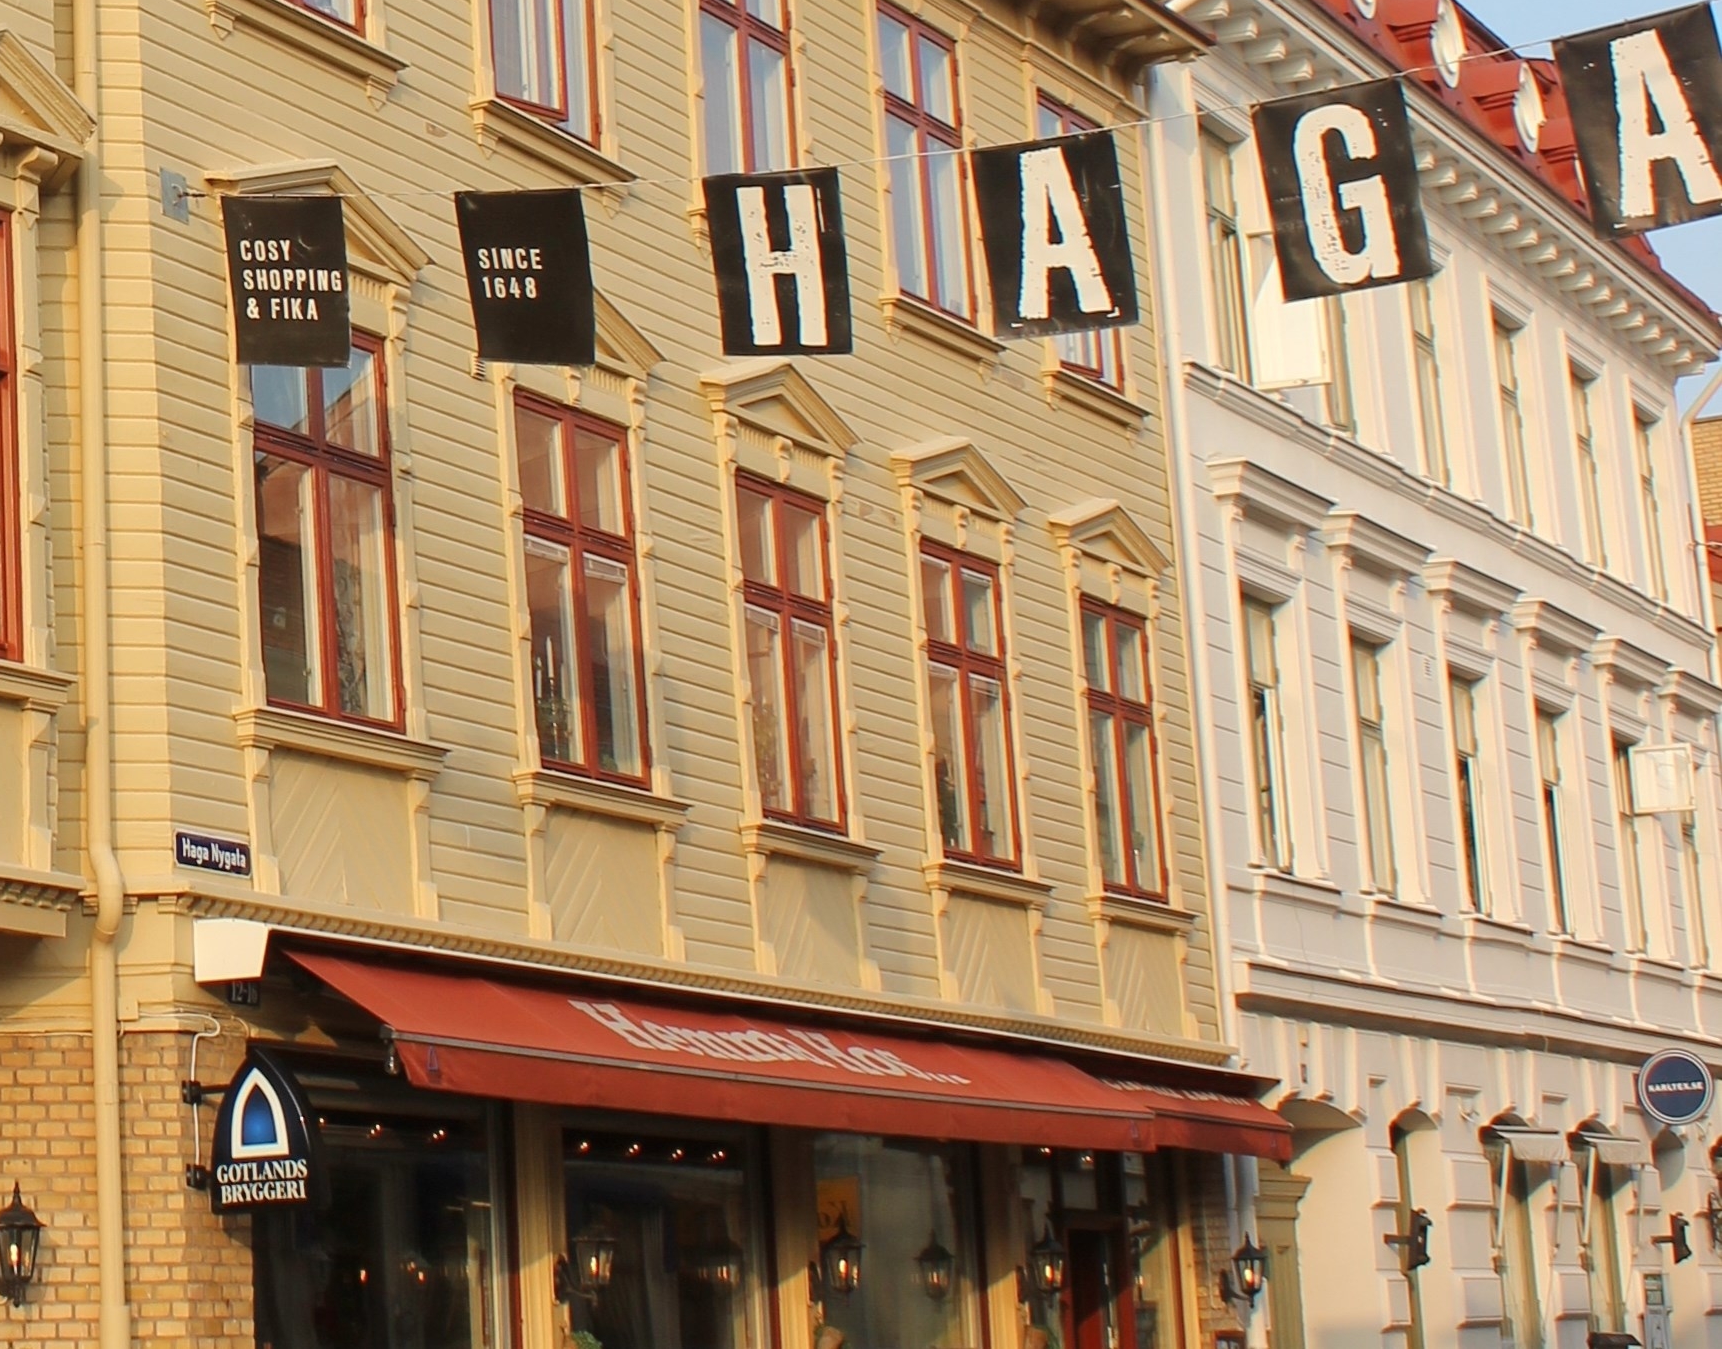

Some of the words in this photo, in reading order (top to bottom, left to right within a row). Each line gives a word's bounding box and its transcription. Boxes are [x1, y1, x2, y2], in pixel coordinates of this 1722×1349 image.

[239, 239, 291, 262] COSY
[477, 247, 543, 270] SINCE
[242, 268, 343, 292] SHOPPING
[481, 276, 537, 299] 1648
[246, 297, 261, 320] &
[270, 297, 319, 322] FIKA
[181, 837, 210, 865] Haga
[568, 999, 816, 1063] Hemma
[216, 1158, 308, 1184] GOTLANDS
[220, 1179, 307, 1205] BRYGGERI
